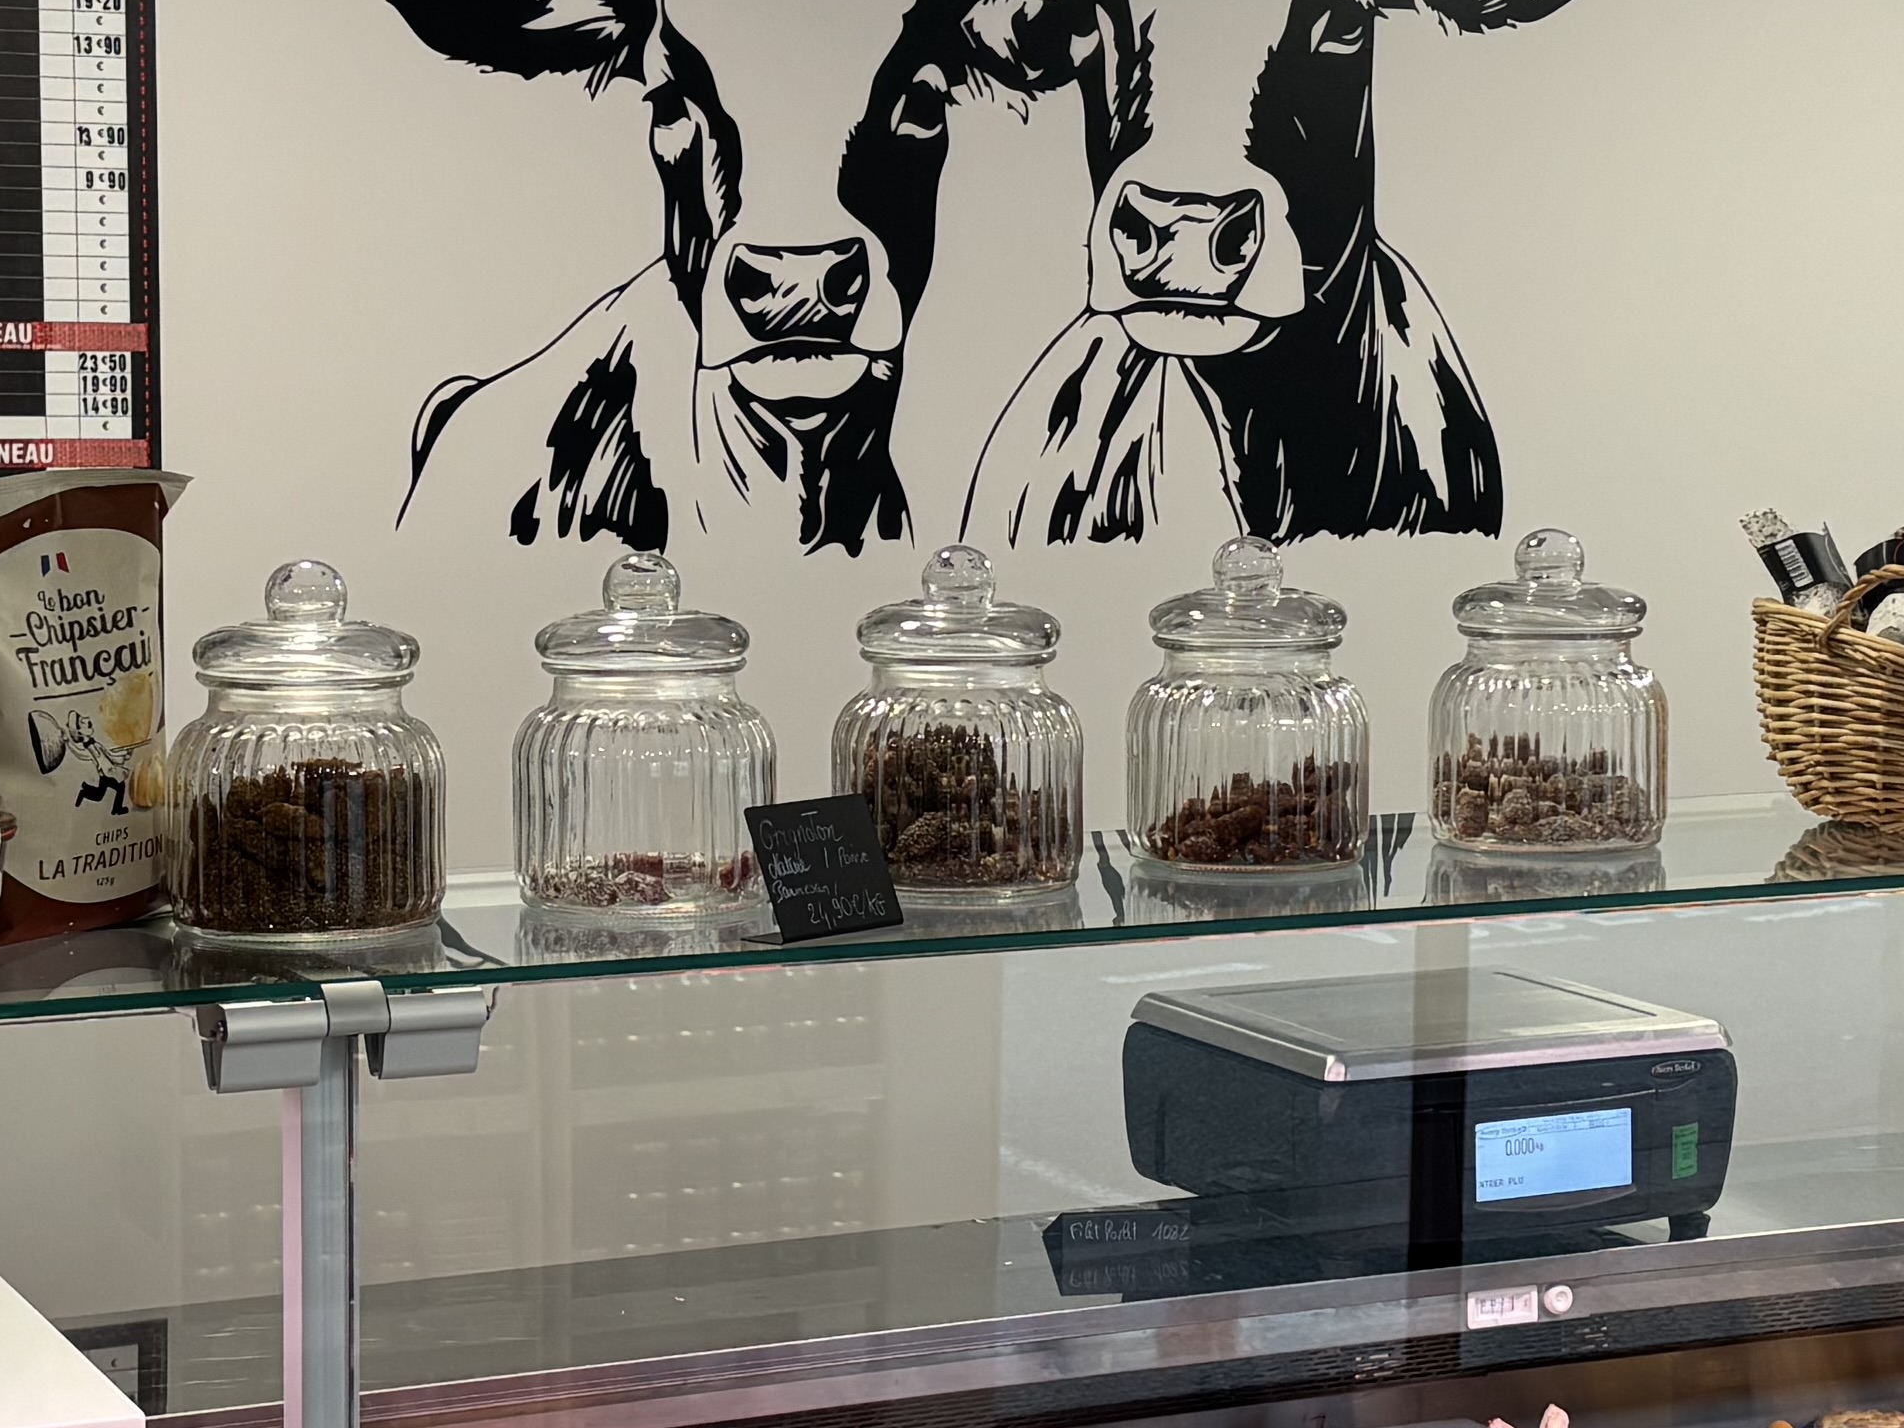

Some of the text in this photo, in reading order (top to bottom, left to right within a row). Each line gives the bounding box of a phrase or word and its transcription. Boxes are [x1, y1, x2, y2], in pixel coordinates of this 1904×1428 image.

[57, 588, 105, 612] bon
[25, 604, 138, 648] Chipsier
[95, 827, 129, 846] CHIPS
[38, 833, 164, 881] LA TRADITION
